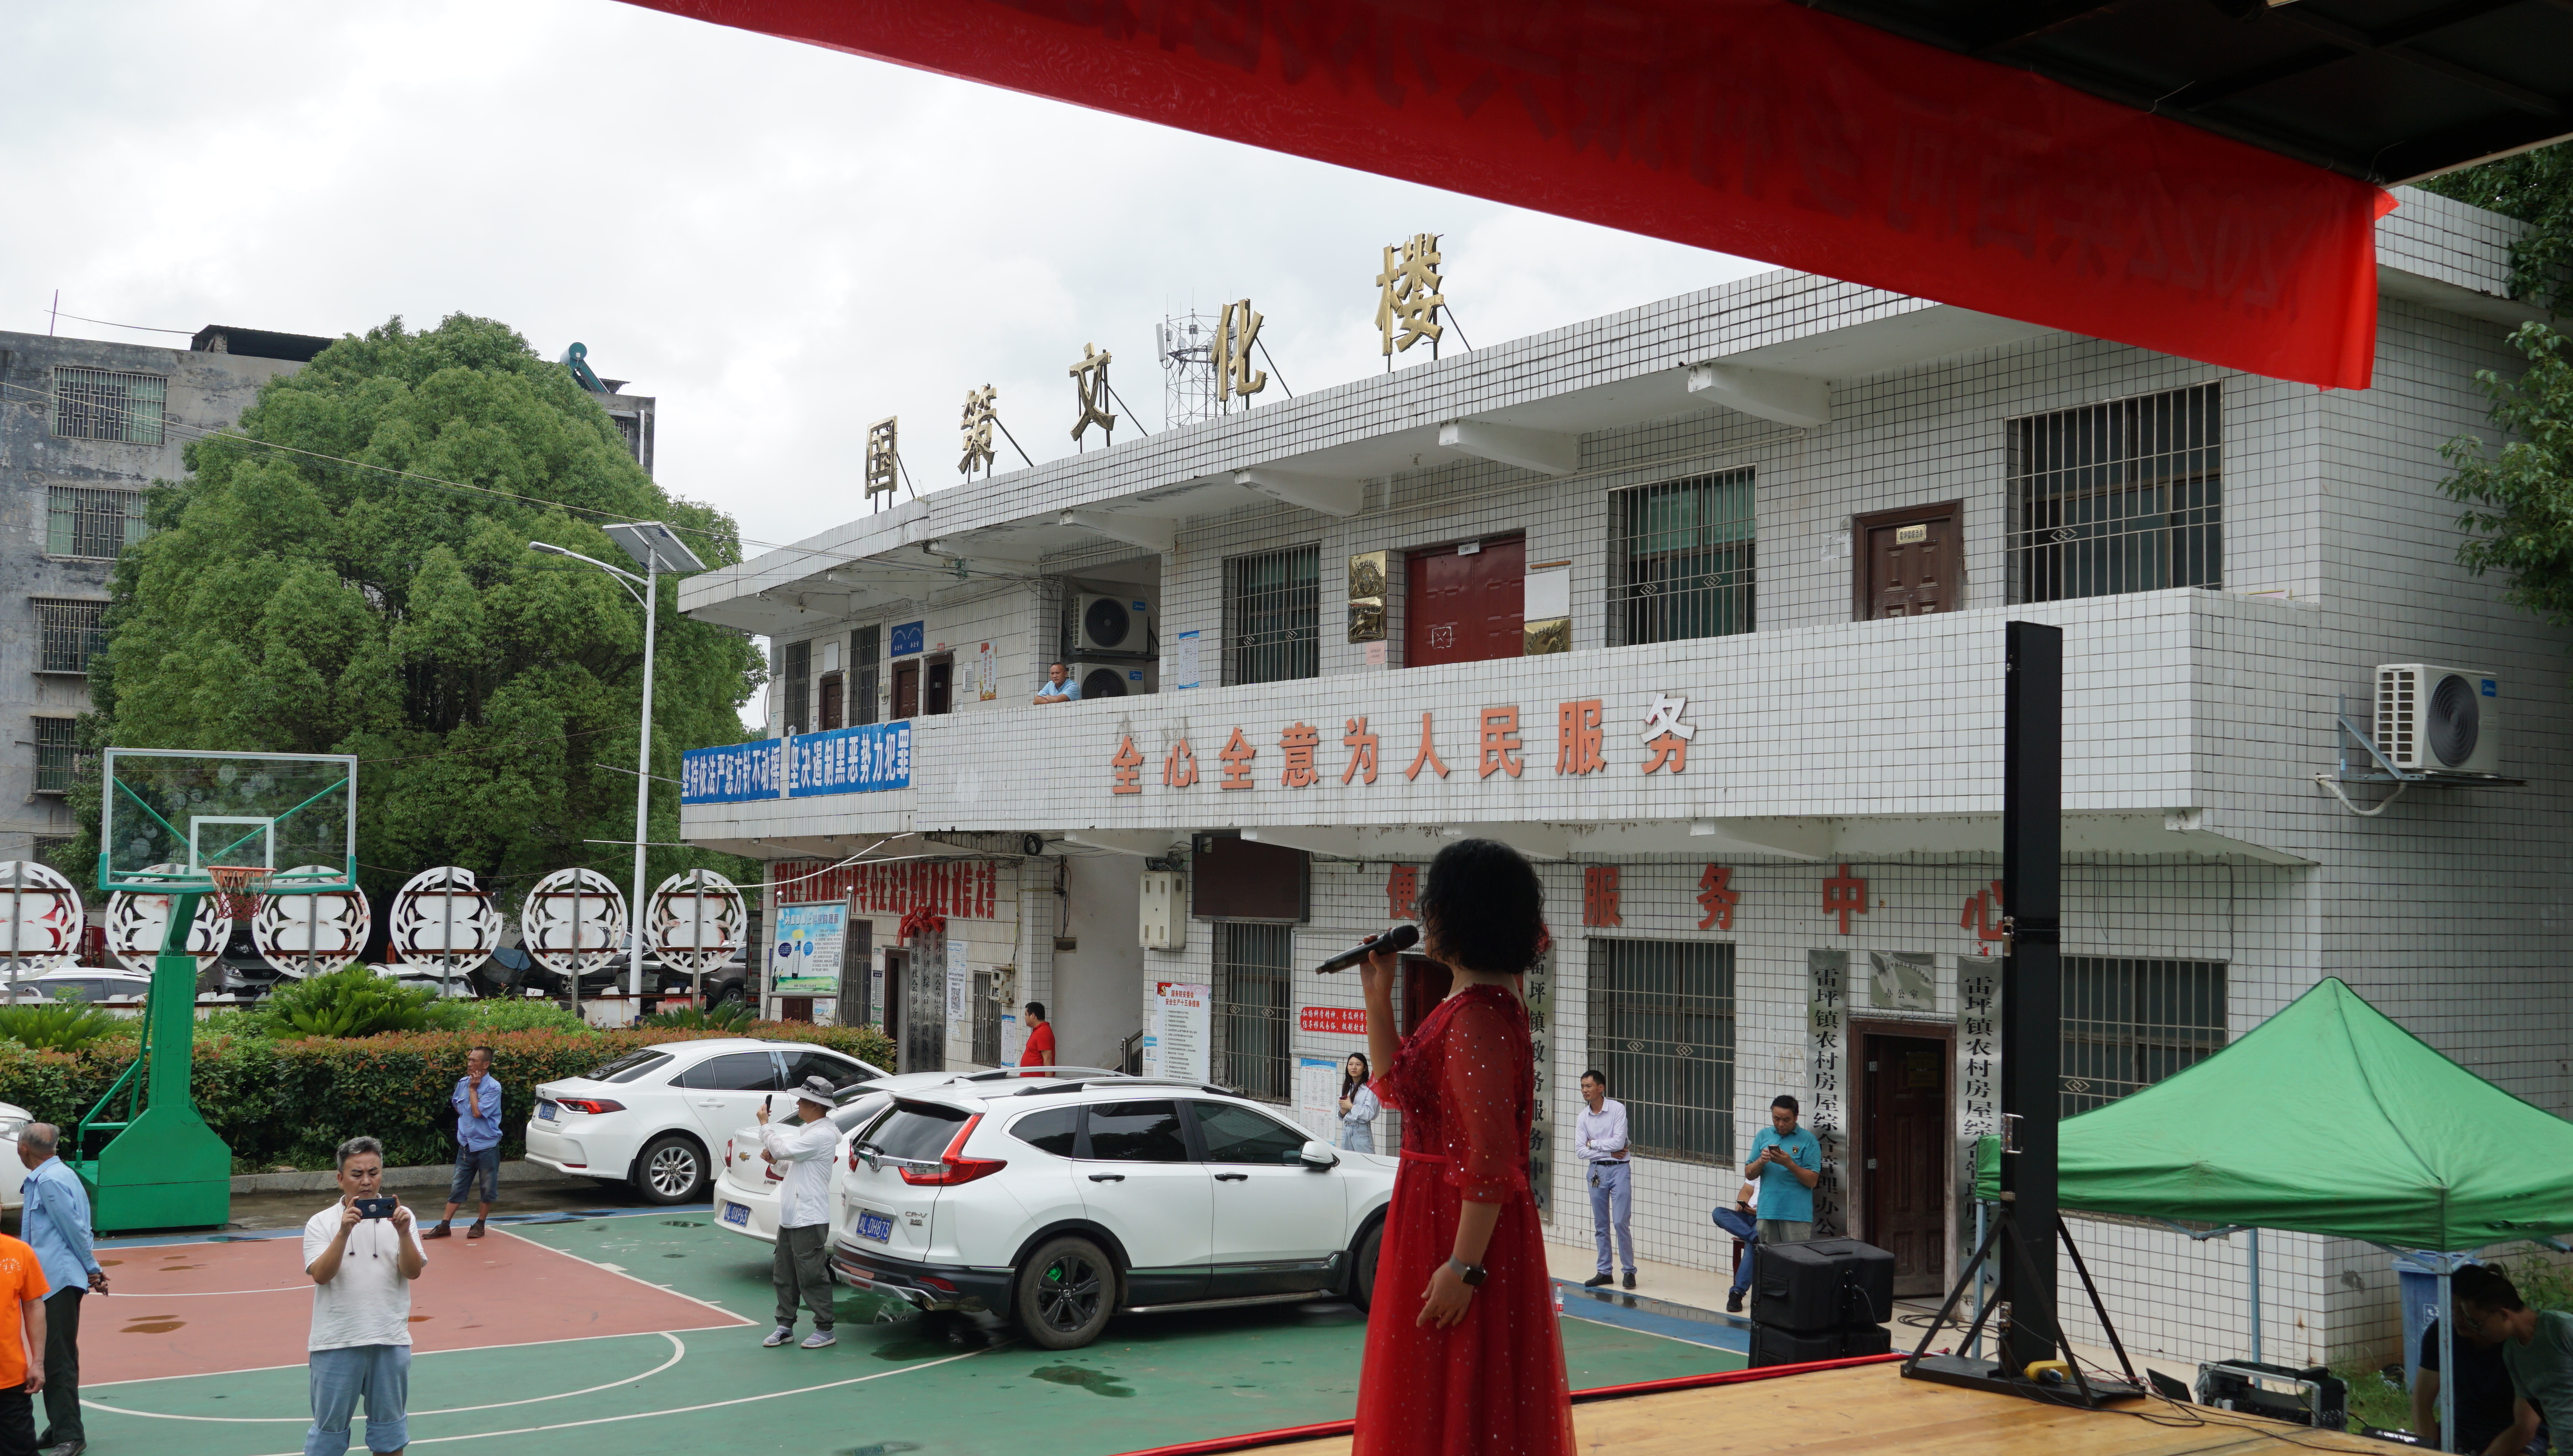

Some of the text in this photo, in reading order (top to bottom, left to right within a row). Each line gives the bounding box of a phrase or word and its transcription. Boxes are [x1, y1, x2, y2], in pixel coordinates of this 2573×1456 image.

[865, 232, 1444, 499] 国策文化楼
[1111, 693, 1696, 794] 全心全意为人民服务
[789, 729, 910, 789] 坚决遏制黑恶势力犯罪
[681, 747, 781, 797] 坚持依法严惩方针不动摇
[1171, 990, 1194, 999] 国务院安委会
[1885, 988, 1918, 999] 办公室
[1165, 999, 1200, 1008] 安全生产十五条措施
[1303, 1009, 1367, 1021] 弘扬科学精神，普及科学
[1302, 1020, 1368, 1033] 倡导移风易俗，抵制封建
